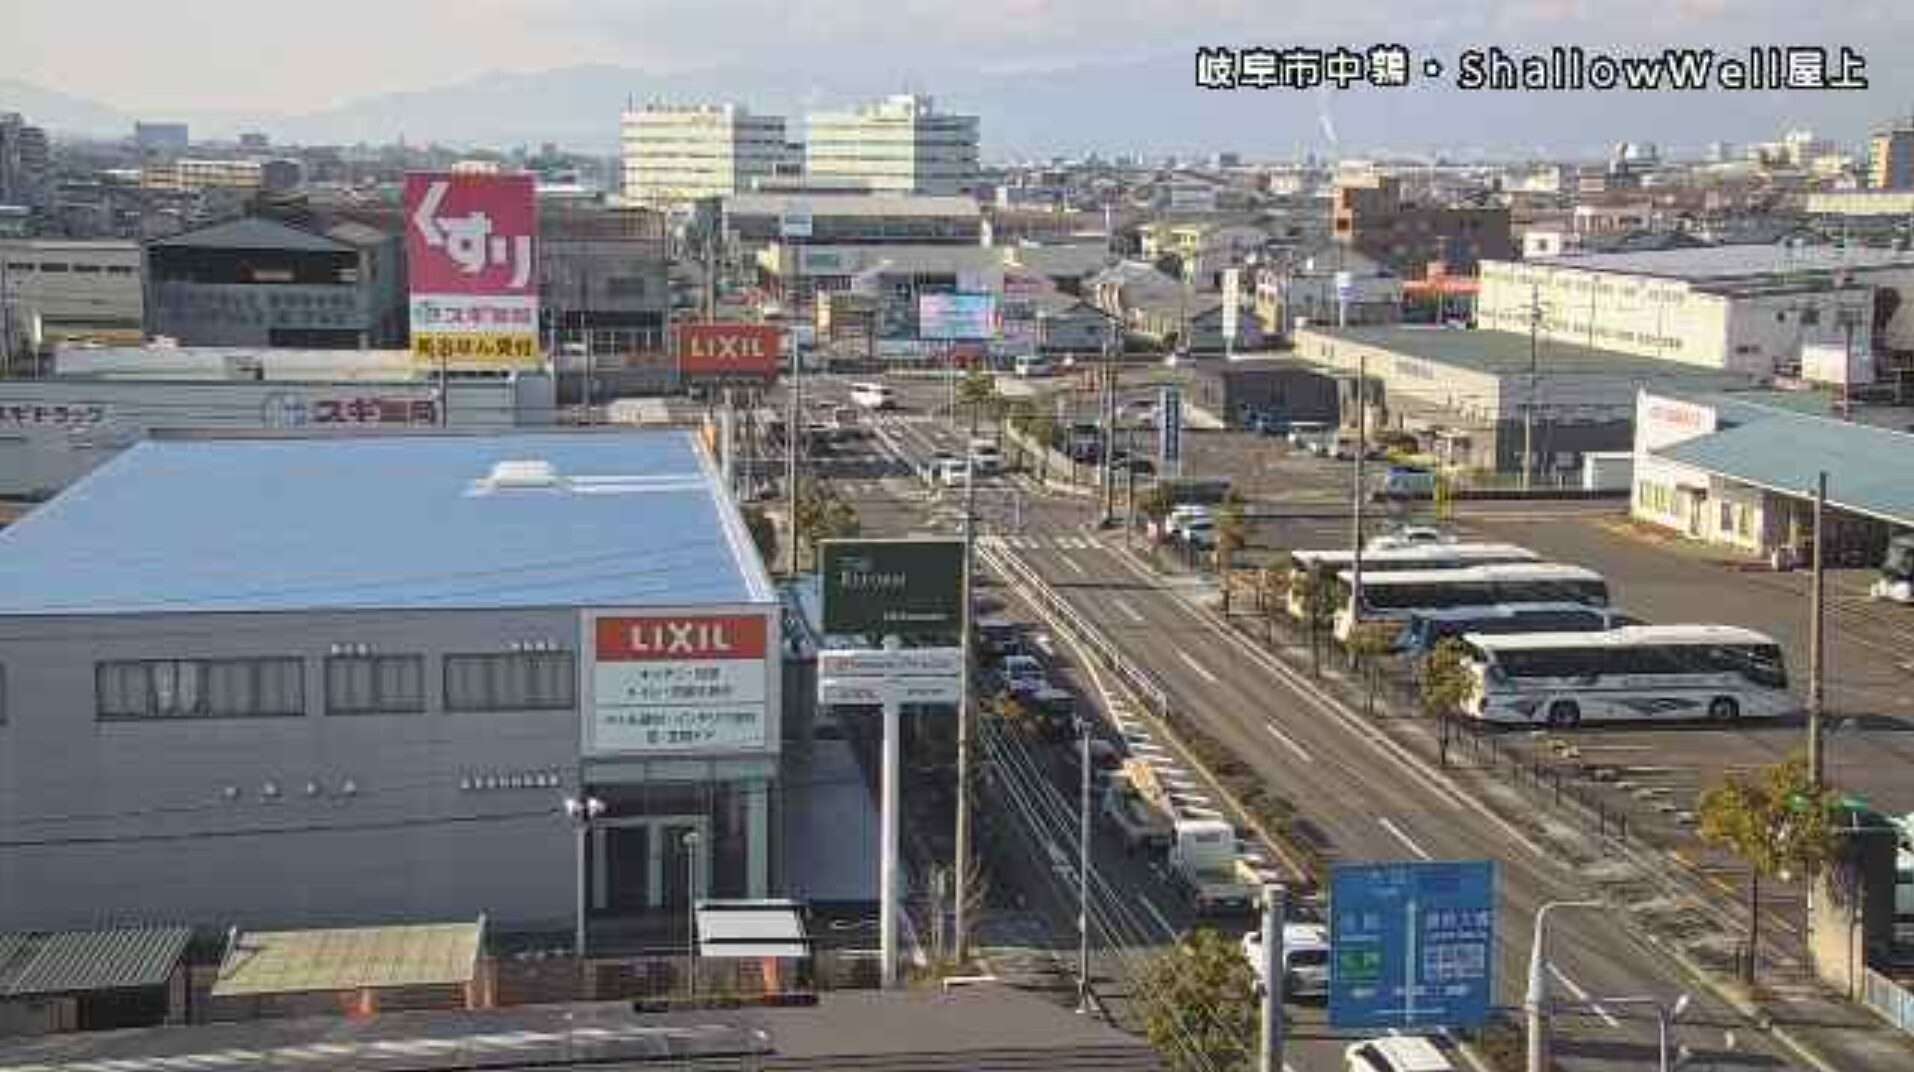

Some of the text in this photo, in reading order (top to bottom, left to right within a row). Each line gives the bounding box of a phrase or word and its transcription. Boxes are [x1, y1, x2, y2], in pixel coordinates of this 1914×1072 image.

[413, 181, 531, 288] くすり
[691, 333, 765, 360] LIXIL
[631, 620, 732, 653] LIXIL
